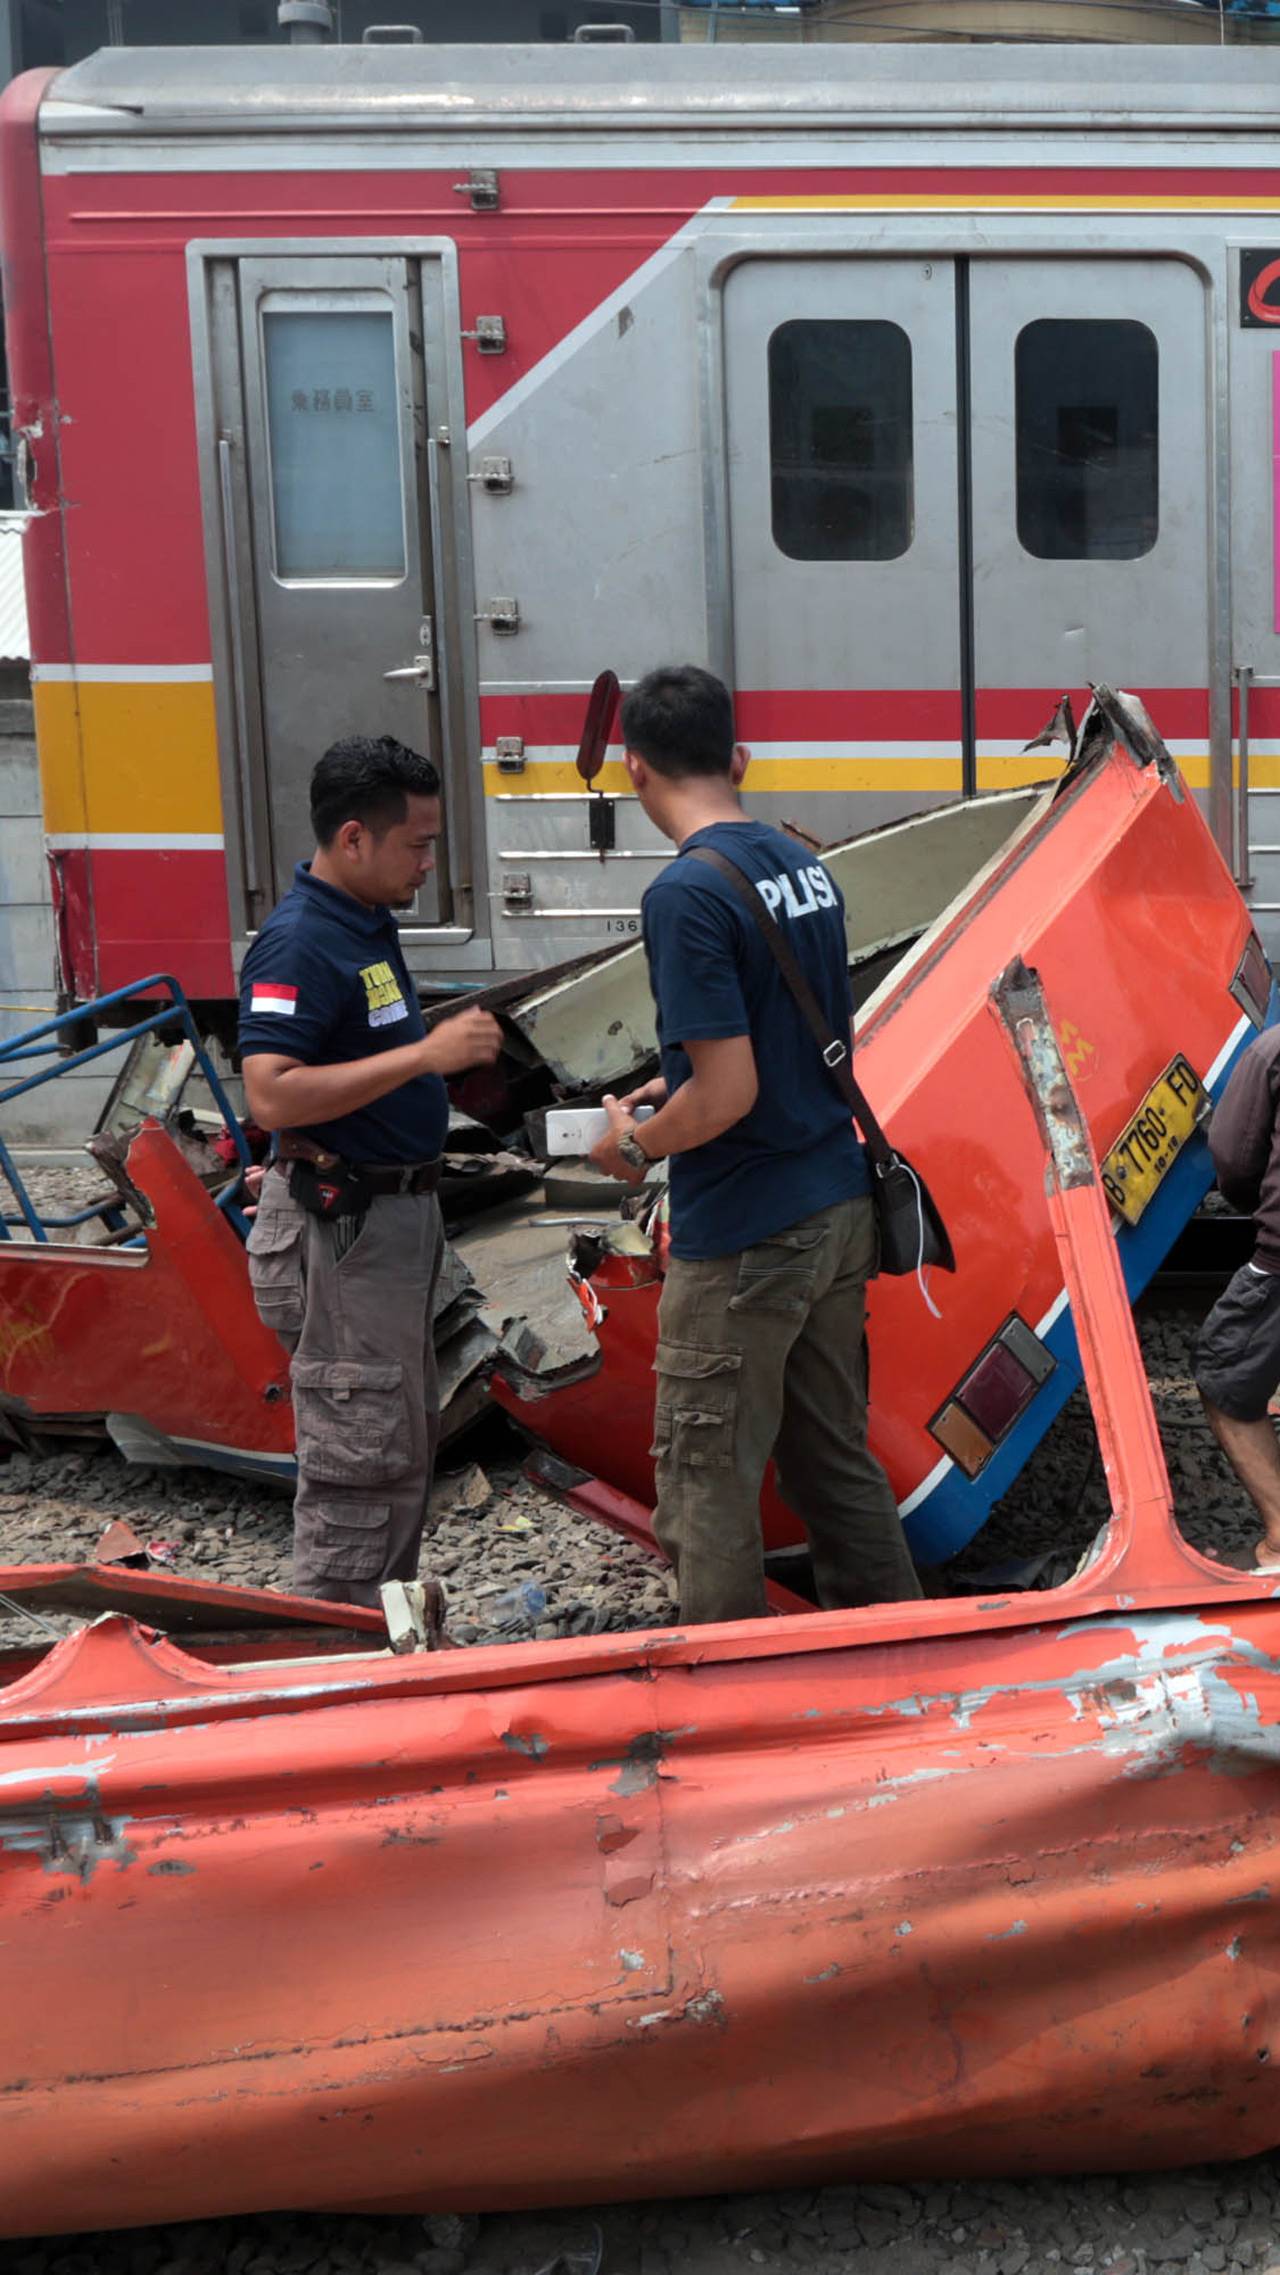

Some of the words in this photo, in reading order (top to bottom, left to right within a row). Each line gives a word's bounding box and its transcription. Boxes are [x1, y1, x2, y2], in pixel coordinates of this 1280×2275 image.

[607, 920, 638, 932] 136
[1101, 1173, 1126, 1206] B
[1119, 1107, 1167, 1174] 7760
